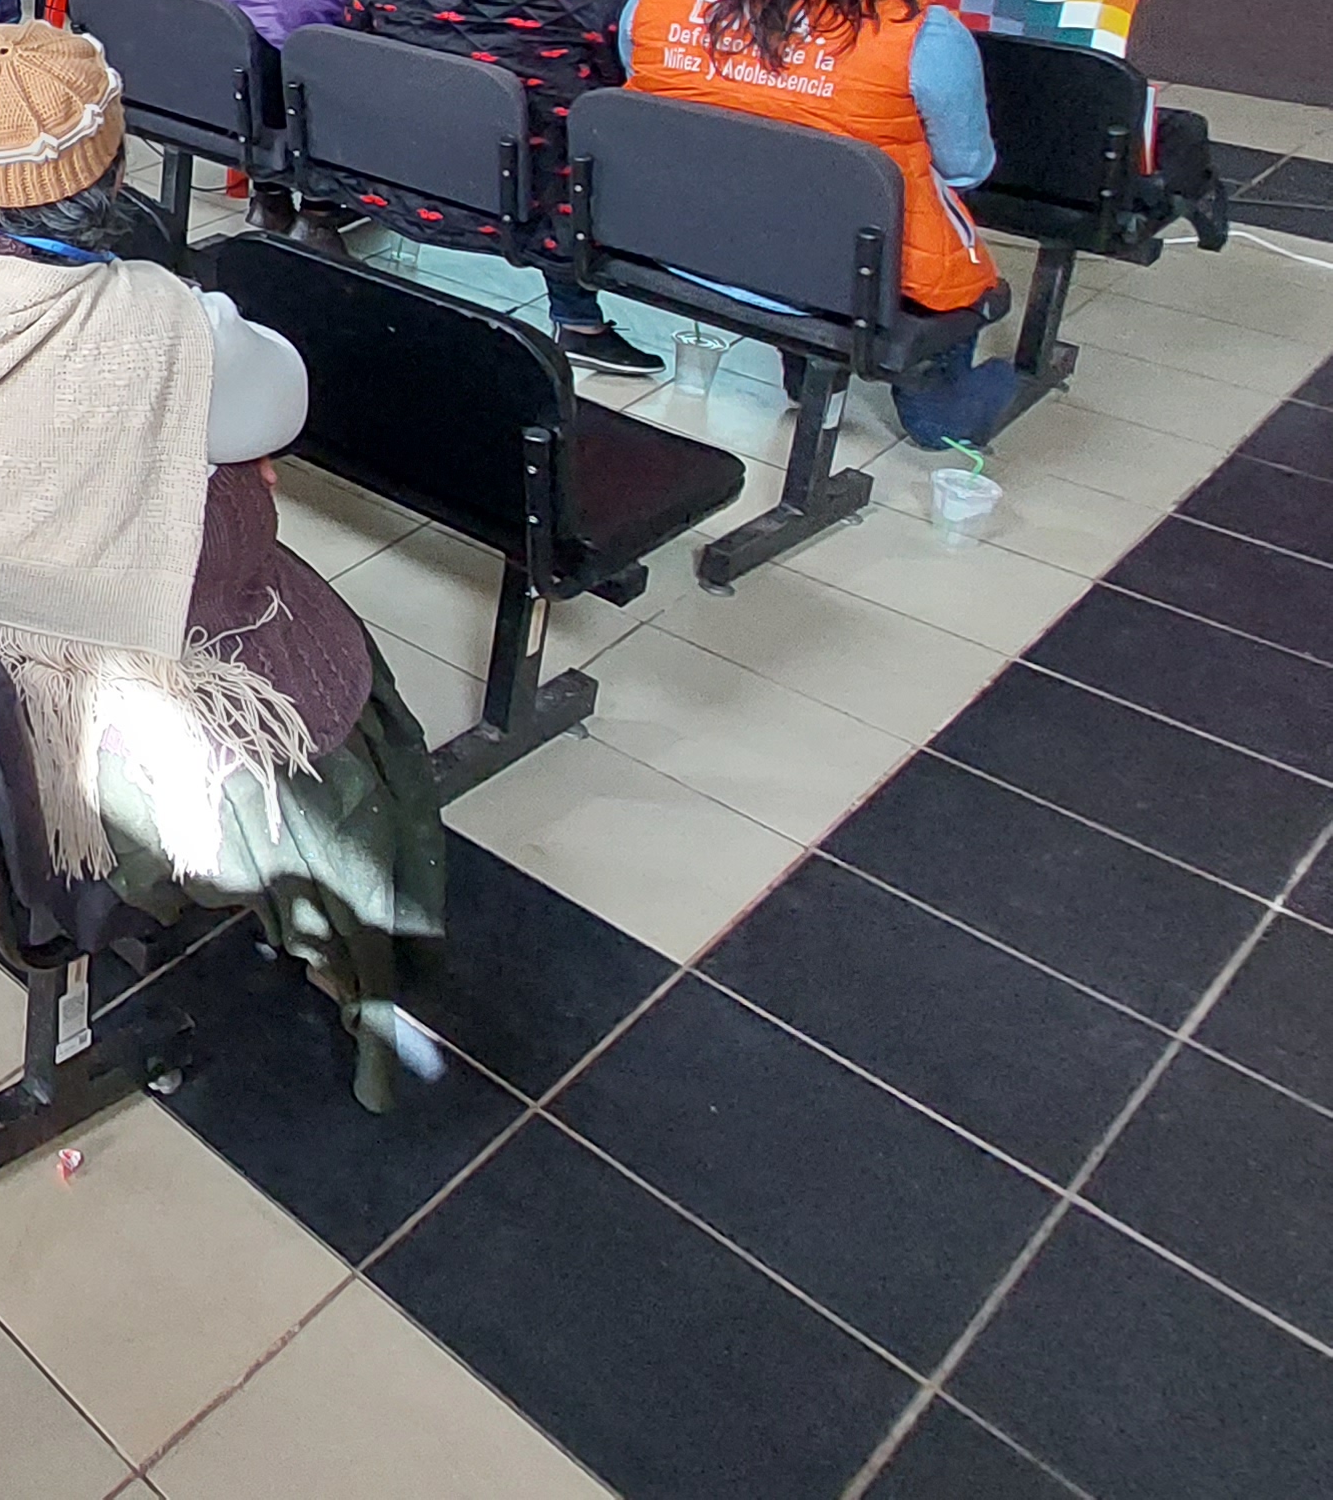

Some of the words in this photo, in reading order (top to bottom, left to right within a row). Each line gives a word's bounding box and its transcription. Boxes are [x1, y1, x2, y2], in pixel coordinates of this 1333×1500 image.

[664, 47, 703, 73] Niñez
[722, 57, 835, 98] Adolescencia
[815, 50, 835, 71] la
